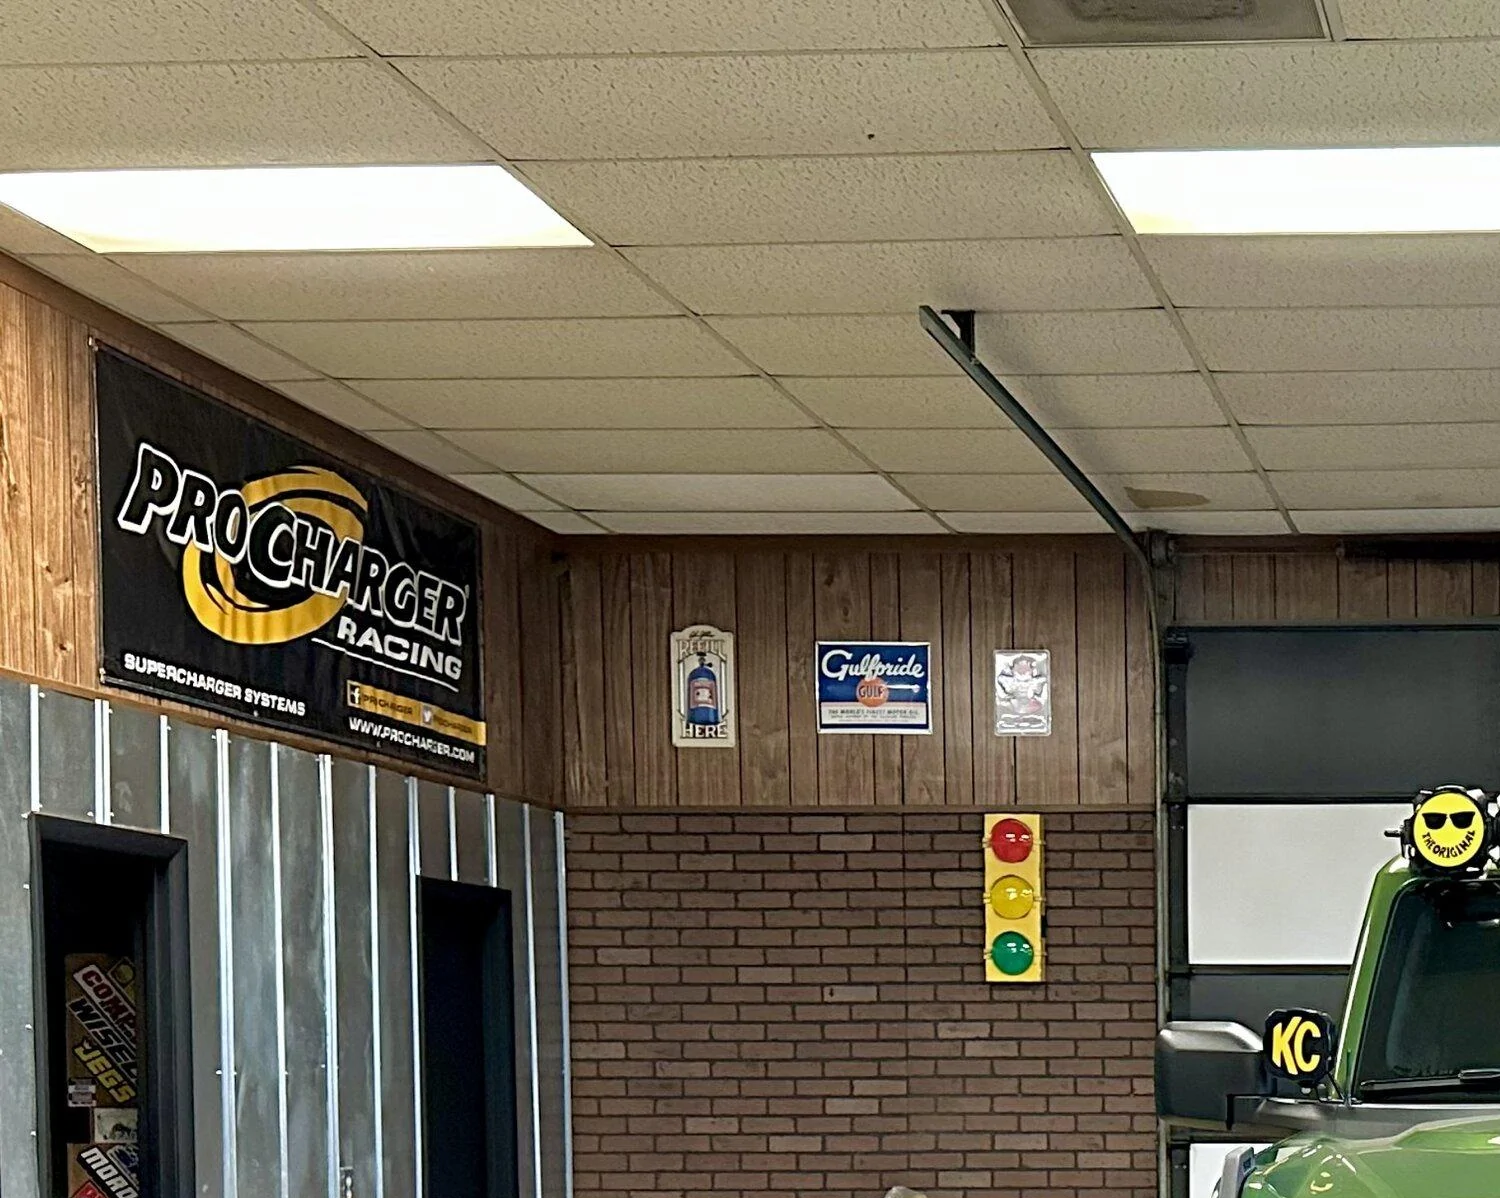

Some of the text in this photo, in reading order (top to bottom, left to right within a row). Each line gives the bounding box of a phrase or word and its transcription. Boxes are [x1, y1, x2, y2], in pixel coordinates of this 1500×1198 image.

[118, 443, 466, 647] PROCHARGER
[336, 615, 463, 680] RACING
[821, 649, 925, 682] Gulfpride
[124, 653, 306, 716] SUPERCHARGER SYSTEMS
[859, 684, 884, 698] GULF
[349, 716, 475, 763] WWW.PROCHARGER.COM
[682, 721, 727, 738] HERE
[1422, 830, 1476, 858] THE ORIGINAL
[1272, 1016, 1321, 1075] KC
[74, 1043, 136, 1103] JEGS
